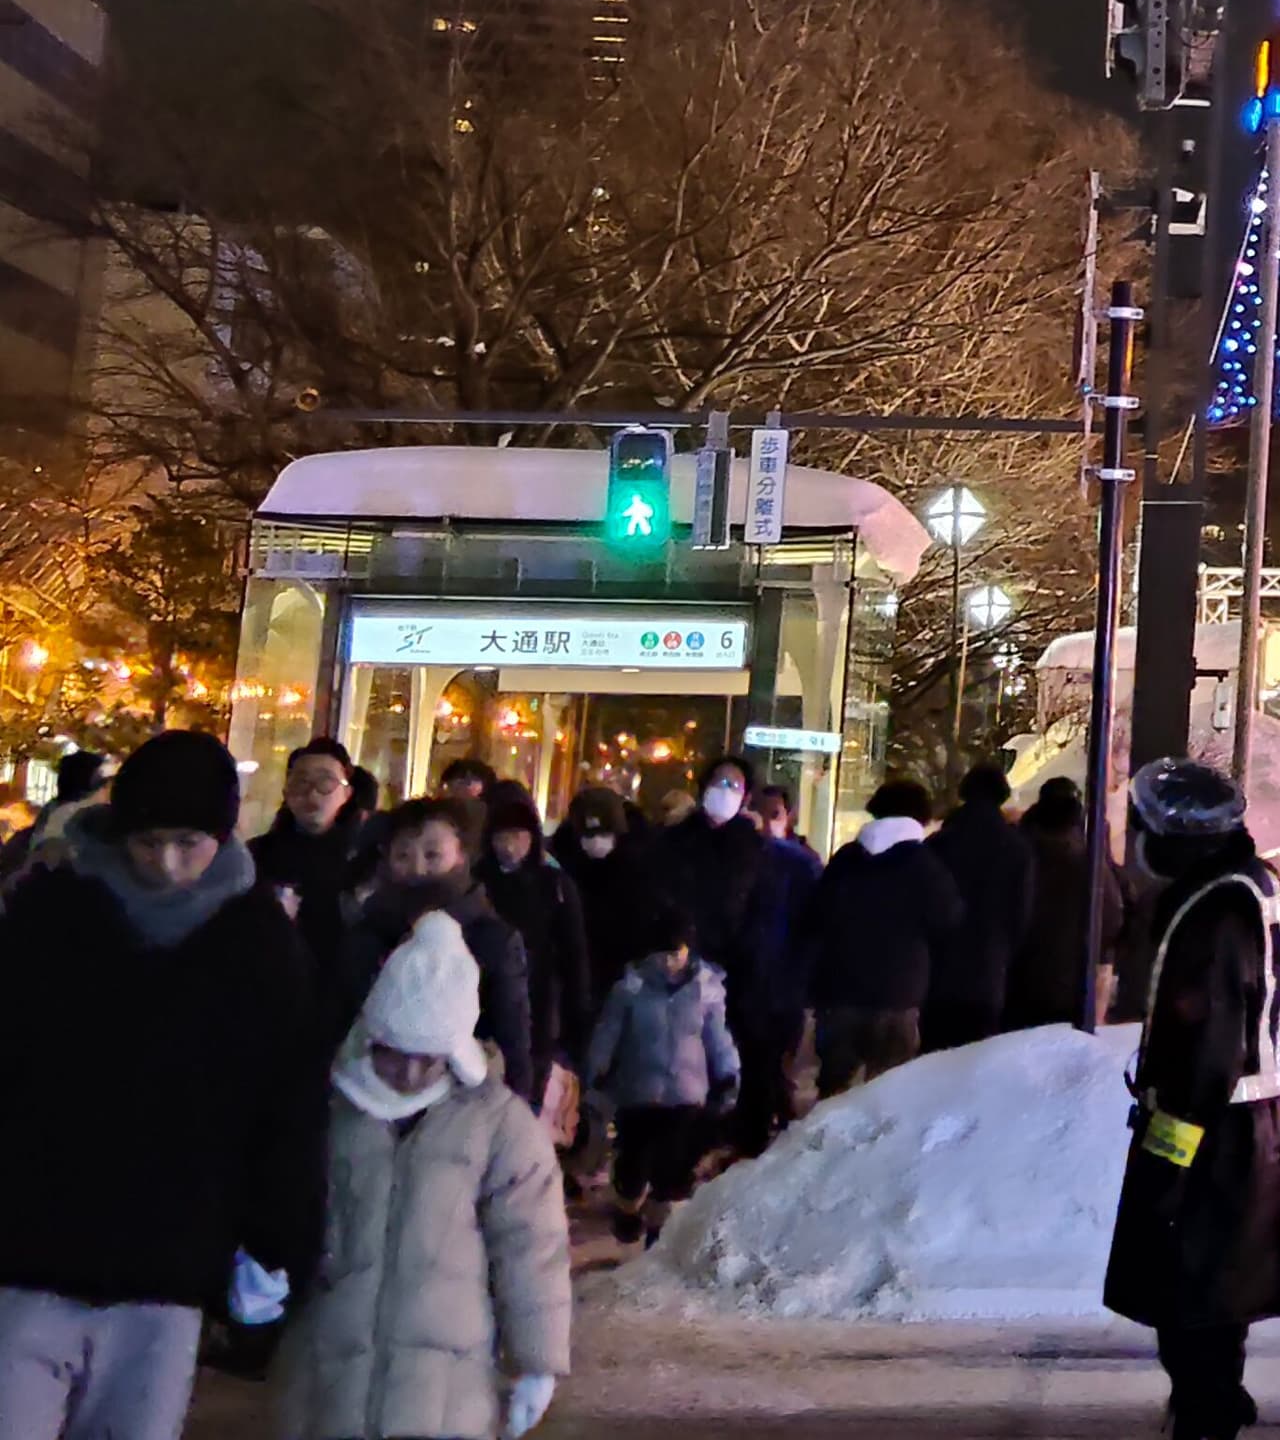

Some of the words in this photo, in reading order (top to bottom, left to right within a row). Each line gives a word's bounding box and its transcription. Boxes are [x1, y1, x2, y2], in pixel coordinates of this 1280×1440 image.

[754, 436, 780, 537] 歩車分離式
[480, 629, 571, 653] 大通駅
[720, 630, 733, 649] 6
